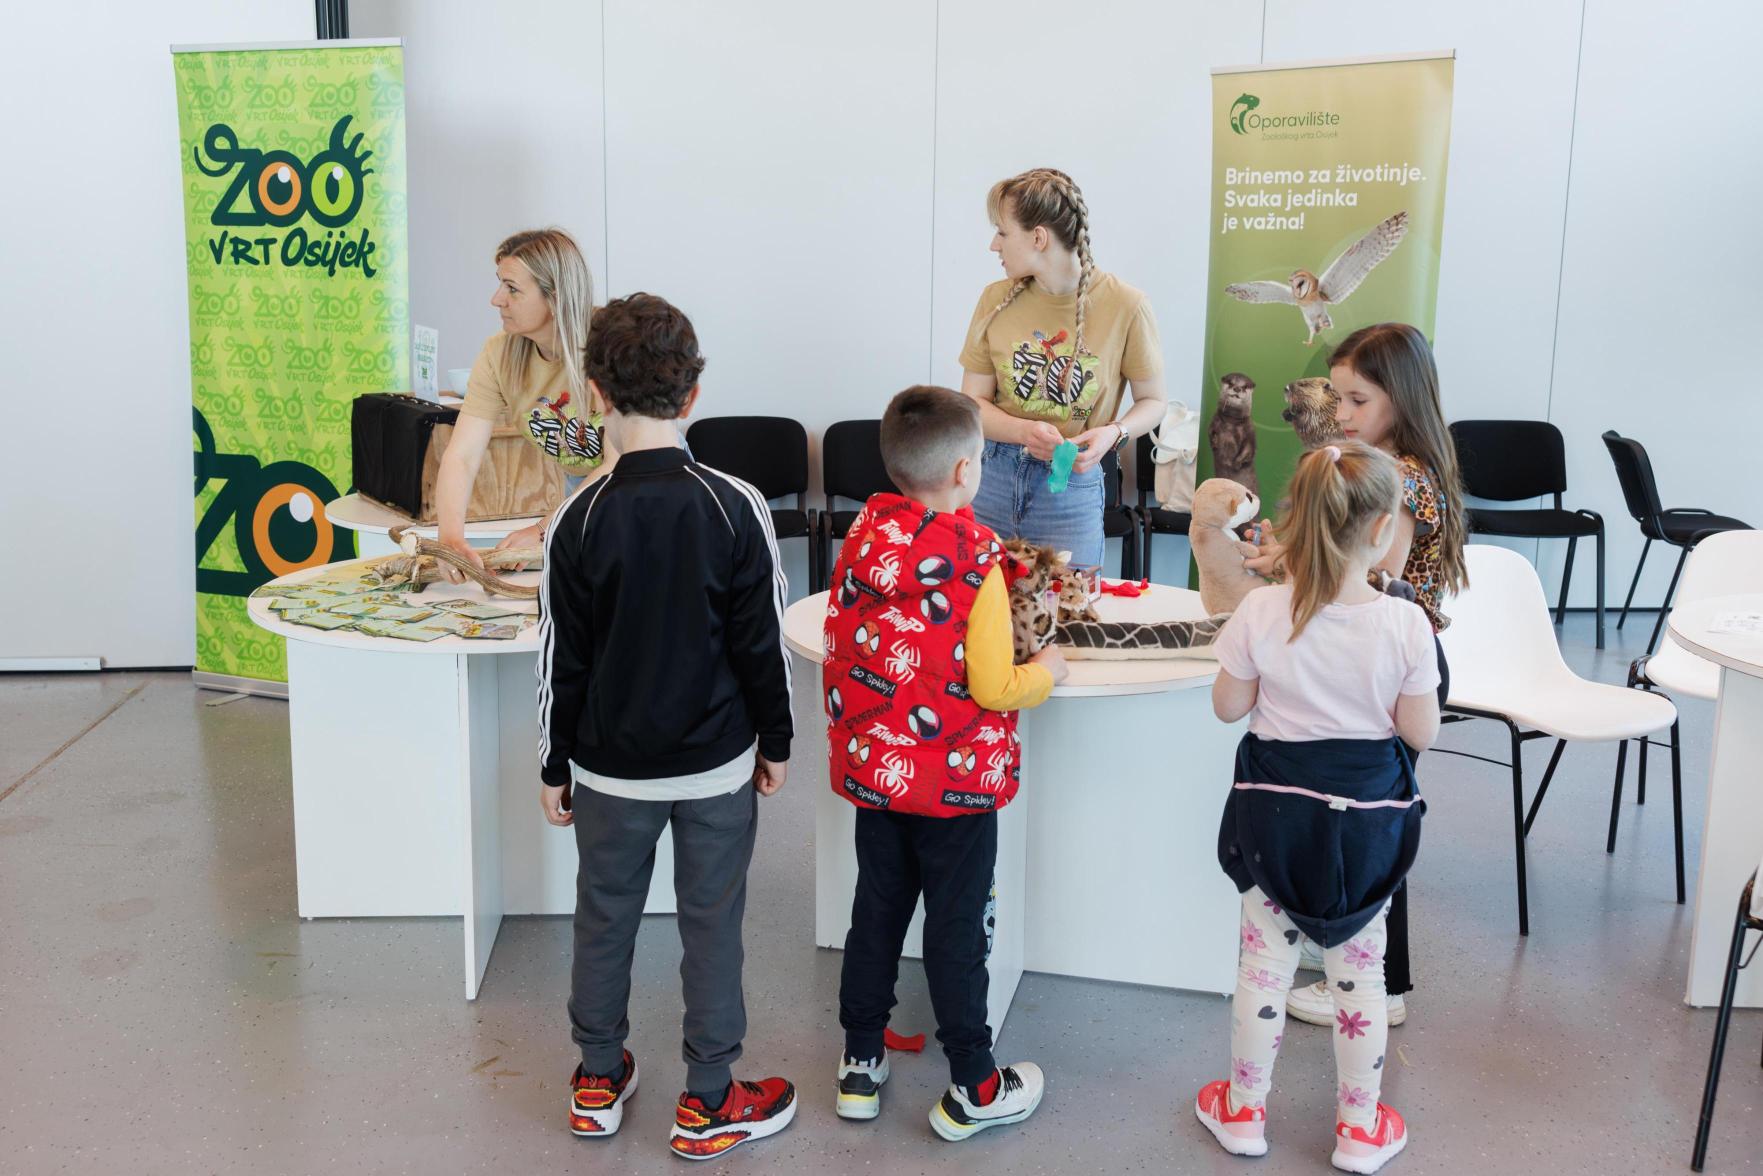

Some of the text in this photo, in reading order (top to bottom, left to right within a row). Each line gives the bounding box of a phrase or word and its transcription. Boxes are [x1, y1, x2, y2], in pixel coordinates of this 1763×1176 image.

[366, 72, 405, 106] ZO
[1248, 111, 1340, 132] Oporavilište
[194, 114, 374, 228] ZOO
[1225, 163, 1427, 186] Brinemo za životinje.
[1224, 188, 1358, 211] Svaka jedinka
[1222, 212, 1305, 234] je važna!
[209, 230, 278, 266] VRT
[280, 227, 378, 279] Osijek
[368, 288, 408, 321] ZO
[193, 404, 362, 598] ZO
[845, 778, 890, 806] Go Spidey!
[944, 792, 995, 808] Go Spidey!
